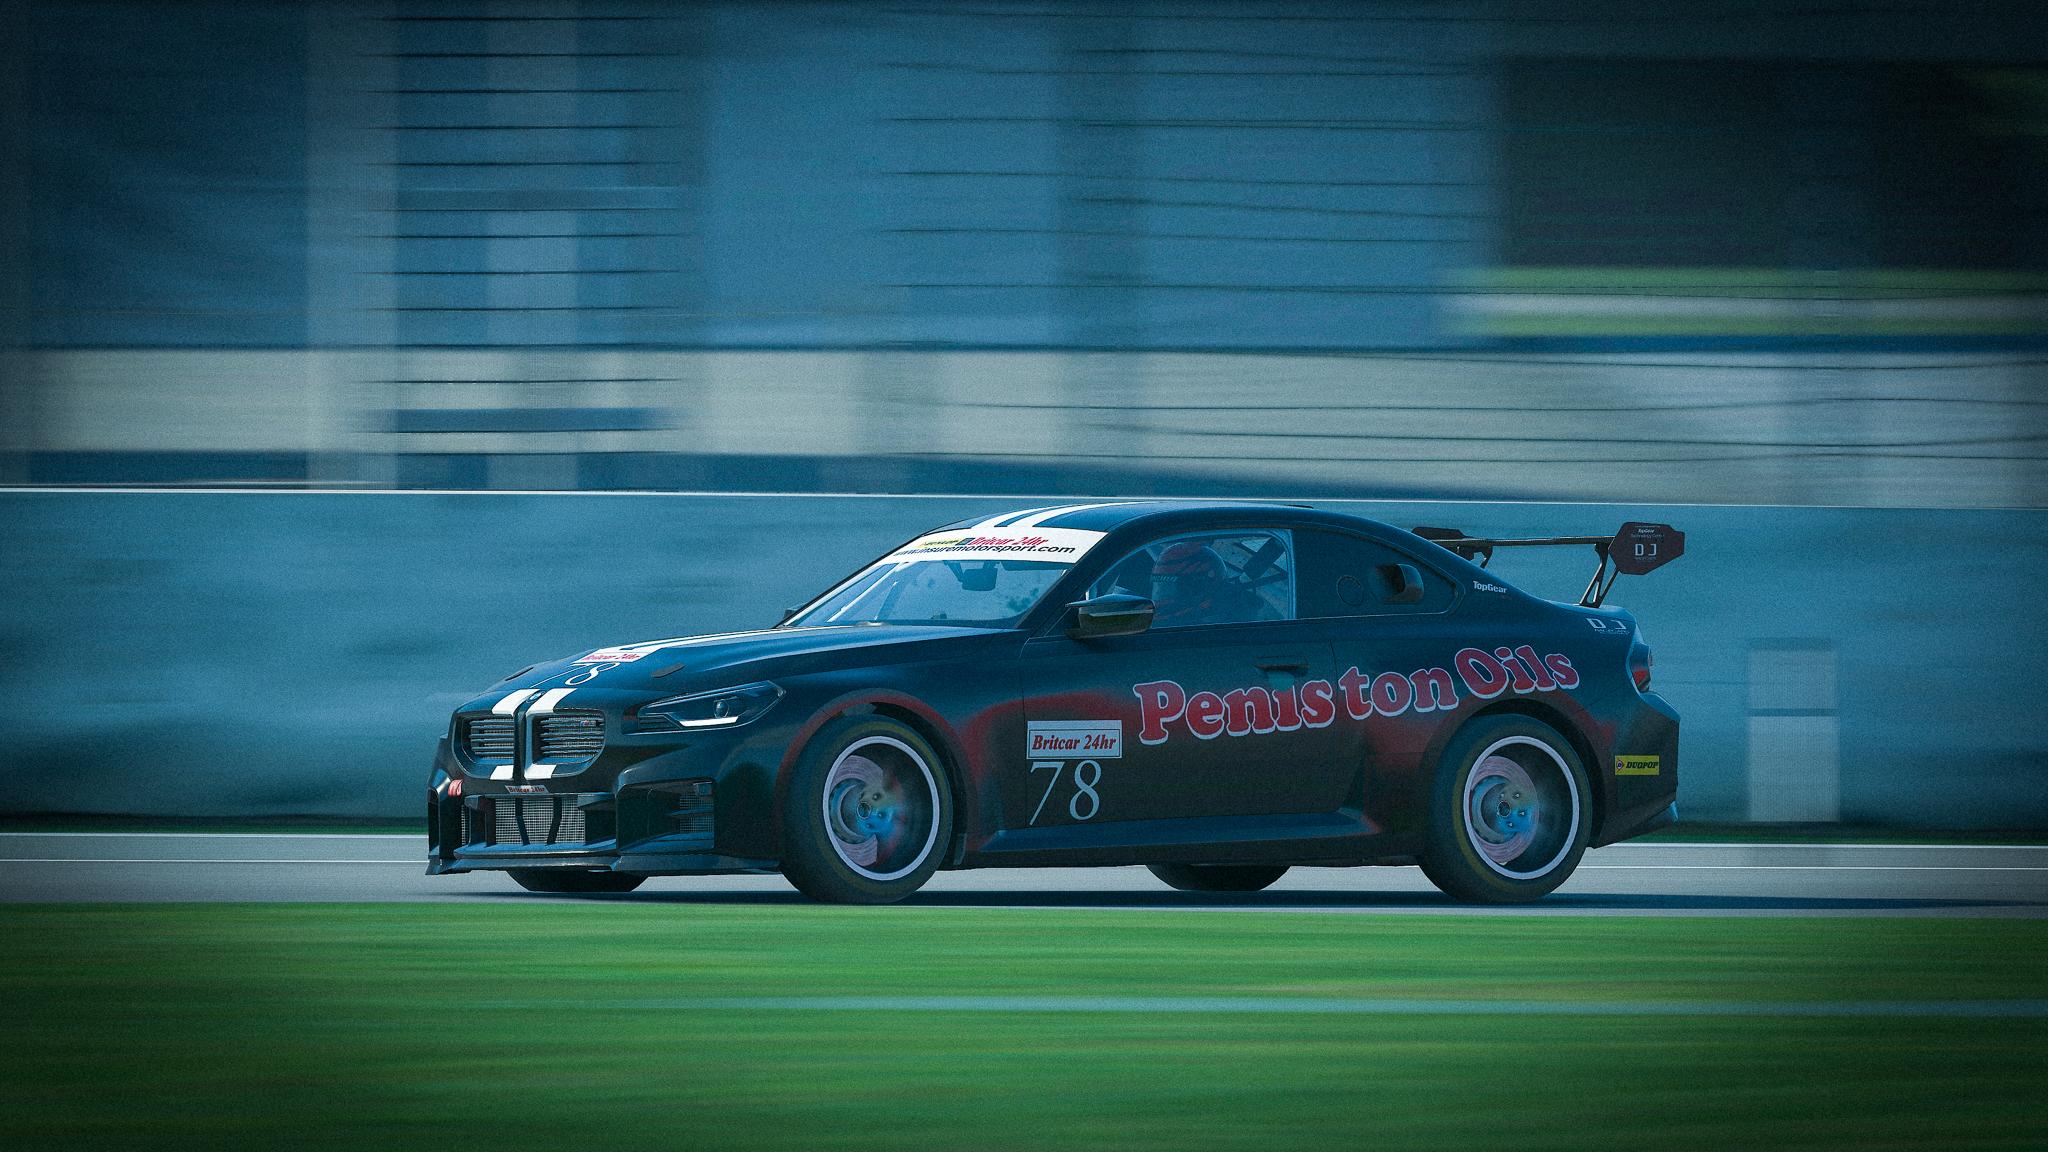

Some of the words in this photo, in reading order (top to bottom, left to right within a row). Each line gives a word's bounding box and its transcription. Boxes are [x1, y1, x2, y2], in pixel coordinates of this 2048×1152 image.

[1472, 580, 1508, 594] TopGear
[1133, 666, 1459, 746] Peniston
[1454, 644, 1580, 700] Oils
[1032, 735, 1081, 750] Britcar
[1083, 734, 1117, 750] 24hr
[1029, 760, 1102, 826] 78
